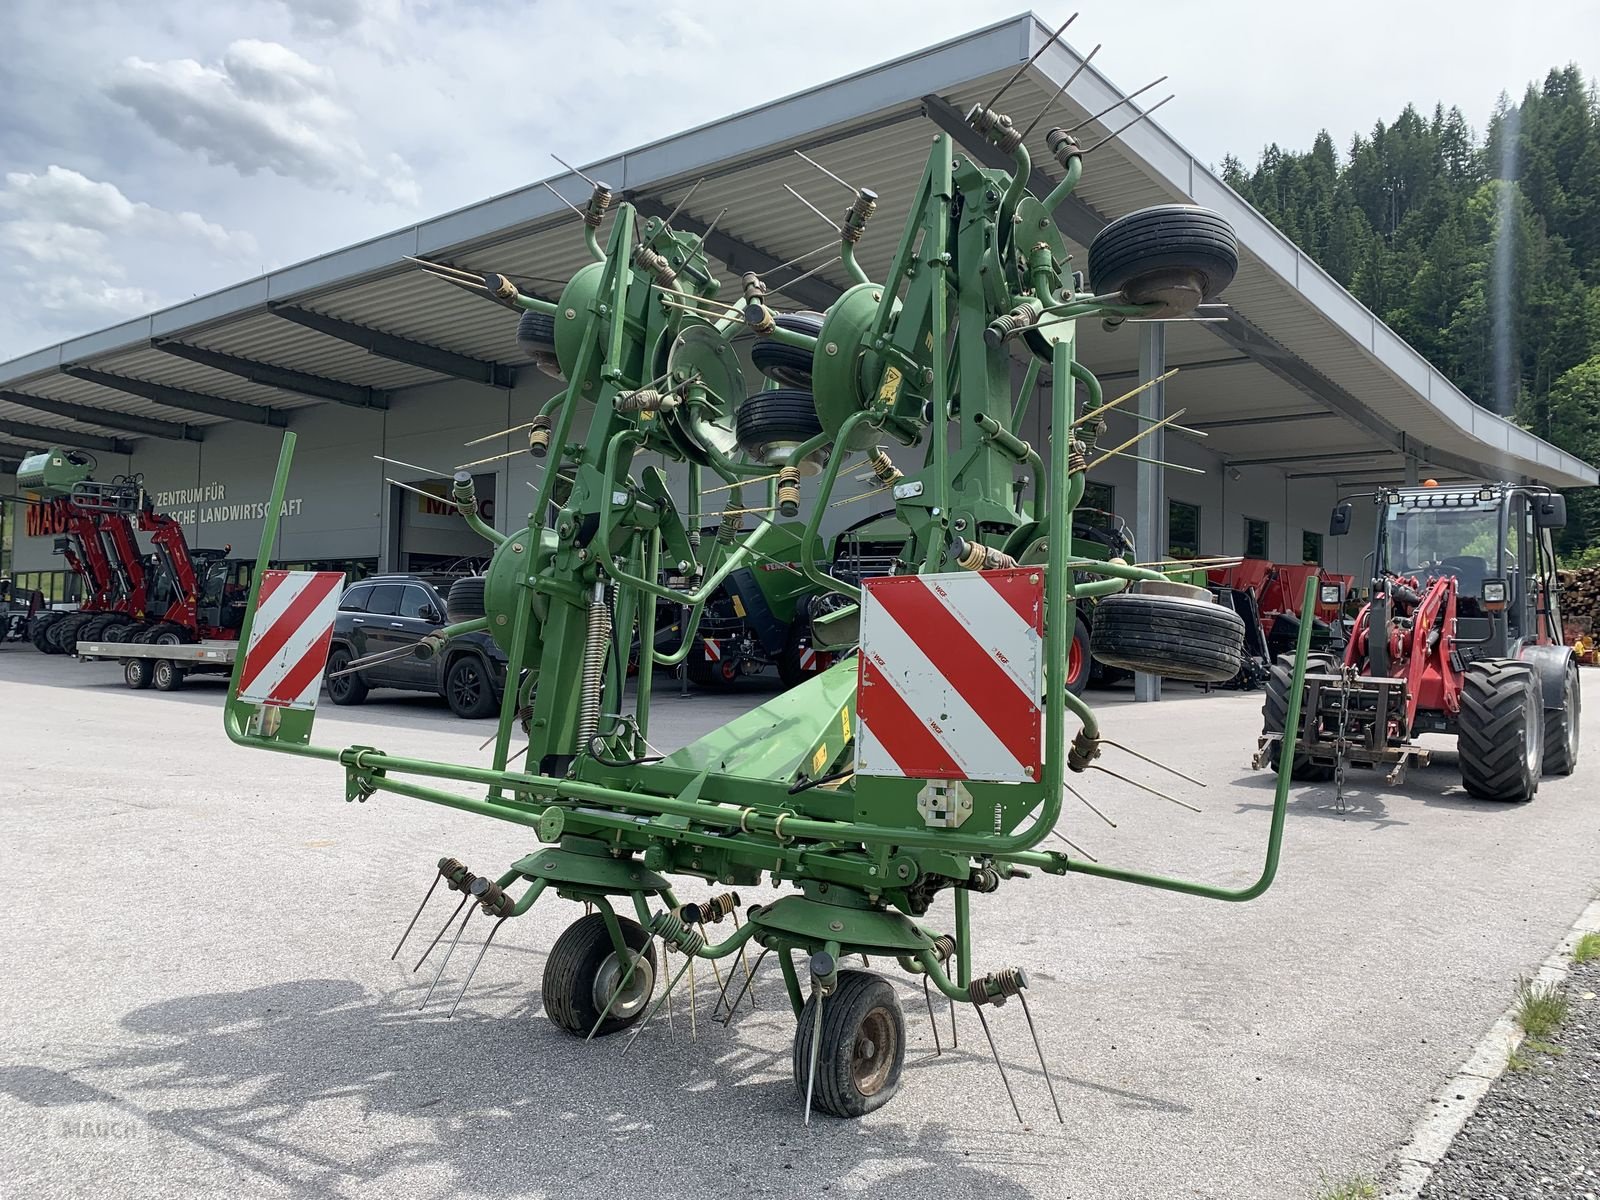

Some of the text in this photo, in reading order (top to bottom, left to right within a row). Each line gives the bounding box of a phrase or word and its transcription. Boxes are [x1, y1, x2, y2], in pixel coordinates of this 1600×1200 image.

[157, 481, 225, 507] ZENTRUM FÜR
[200, 499, 302, 523] LANDWIRTSCAFT
[934, 584, 947, 598] WGF
[873, 653, 886, 666] WGF
[995, 650, 1010, 665] WGF
[930, 720, 943, 734] WGF
